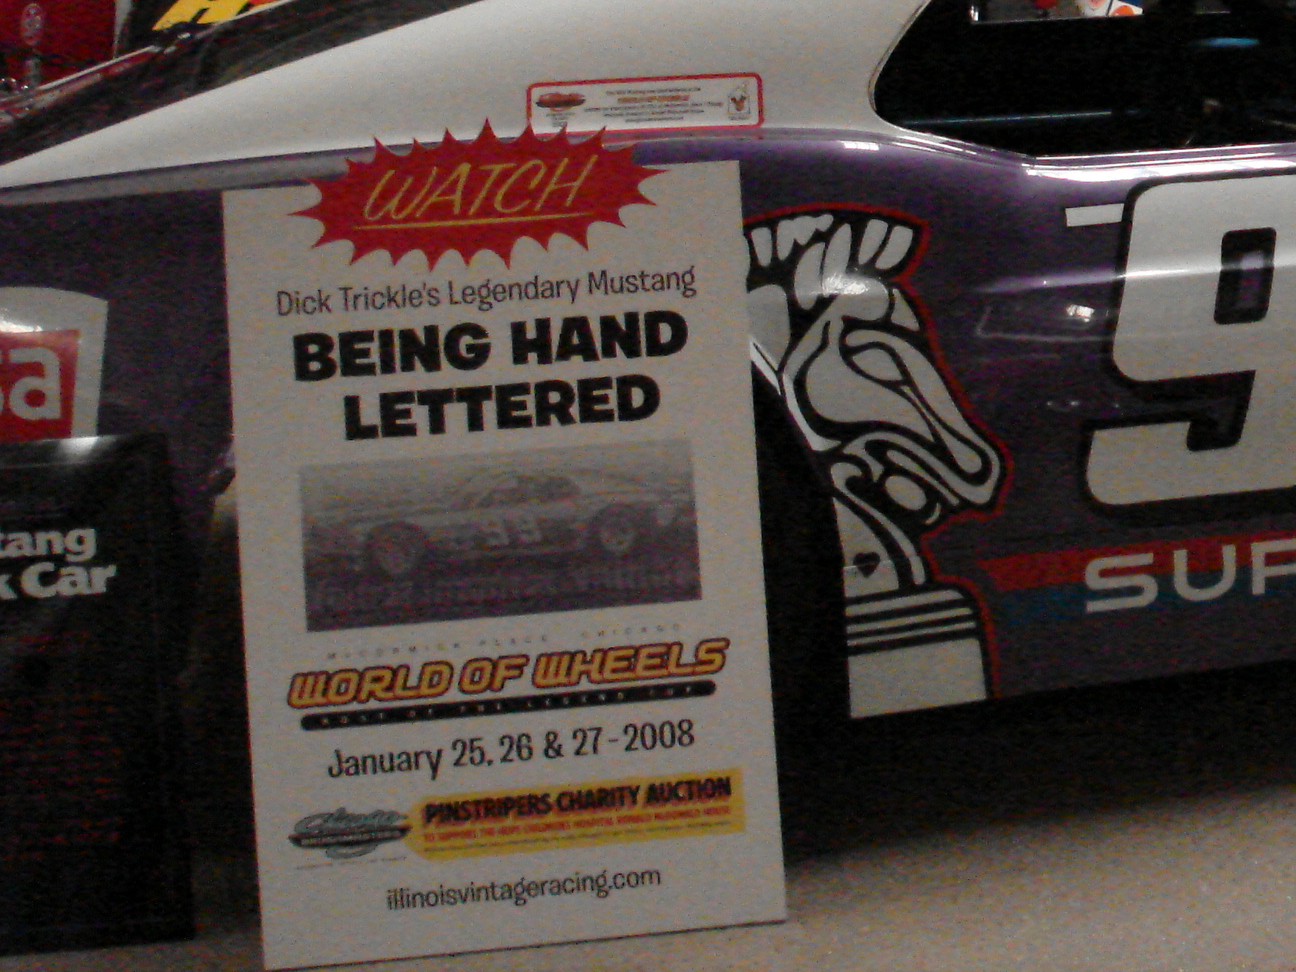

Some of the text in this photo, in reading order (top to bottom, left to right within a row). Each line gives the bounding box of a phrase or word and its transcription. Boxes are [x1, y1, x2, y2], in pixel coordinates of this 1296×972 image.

[363, 154, 598, 221] WATCH
[276, 265, 697, 317] Dick Trickle's Legendary Mustang
[293, 310, 690, 382] BEING HAND
[344, 374, 662, 441] LETTERED
[20, 561, 117, 599] Car
[287, 637, 731, 709] WORLD OF WHEELS
[329, 748, 443, 781] January
[500, 733, 534, 762] 26
[544, 731, 564, 759] &
[424, 792, 552, 825] PINSTRIPERS
[556, 785, 640, 812] CHARITY
[646, 776, 732, 804] AUCTION
[386, 867, 662, 911] illinoisvintageracing.com
